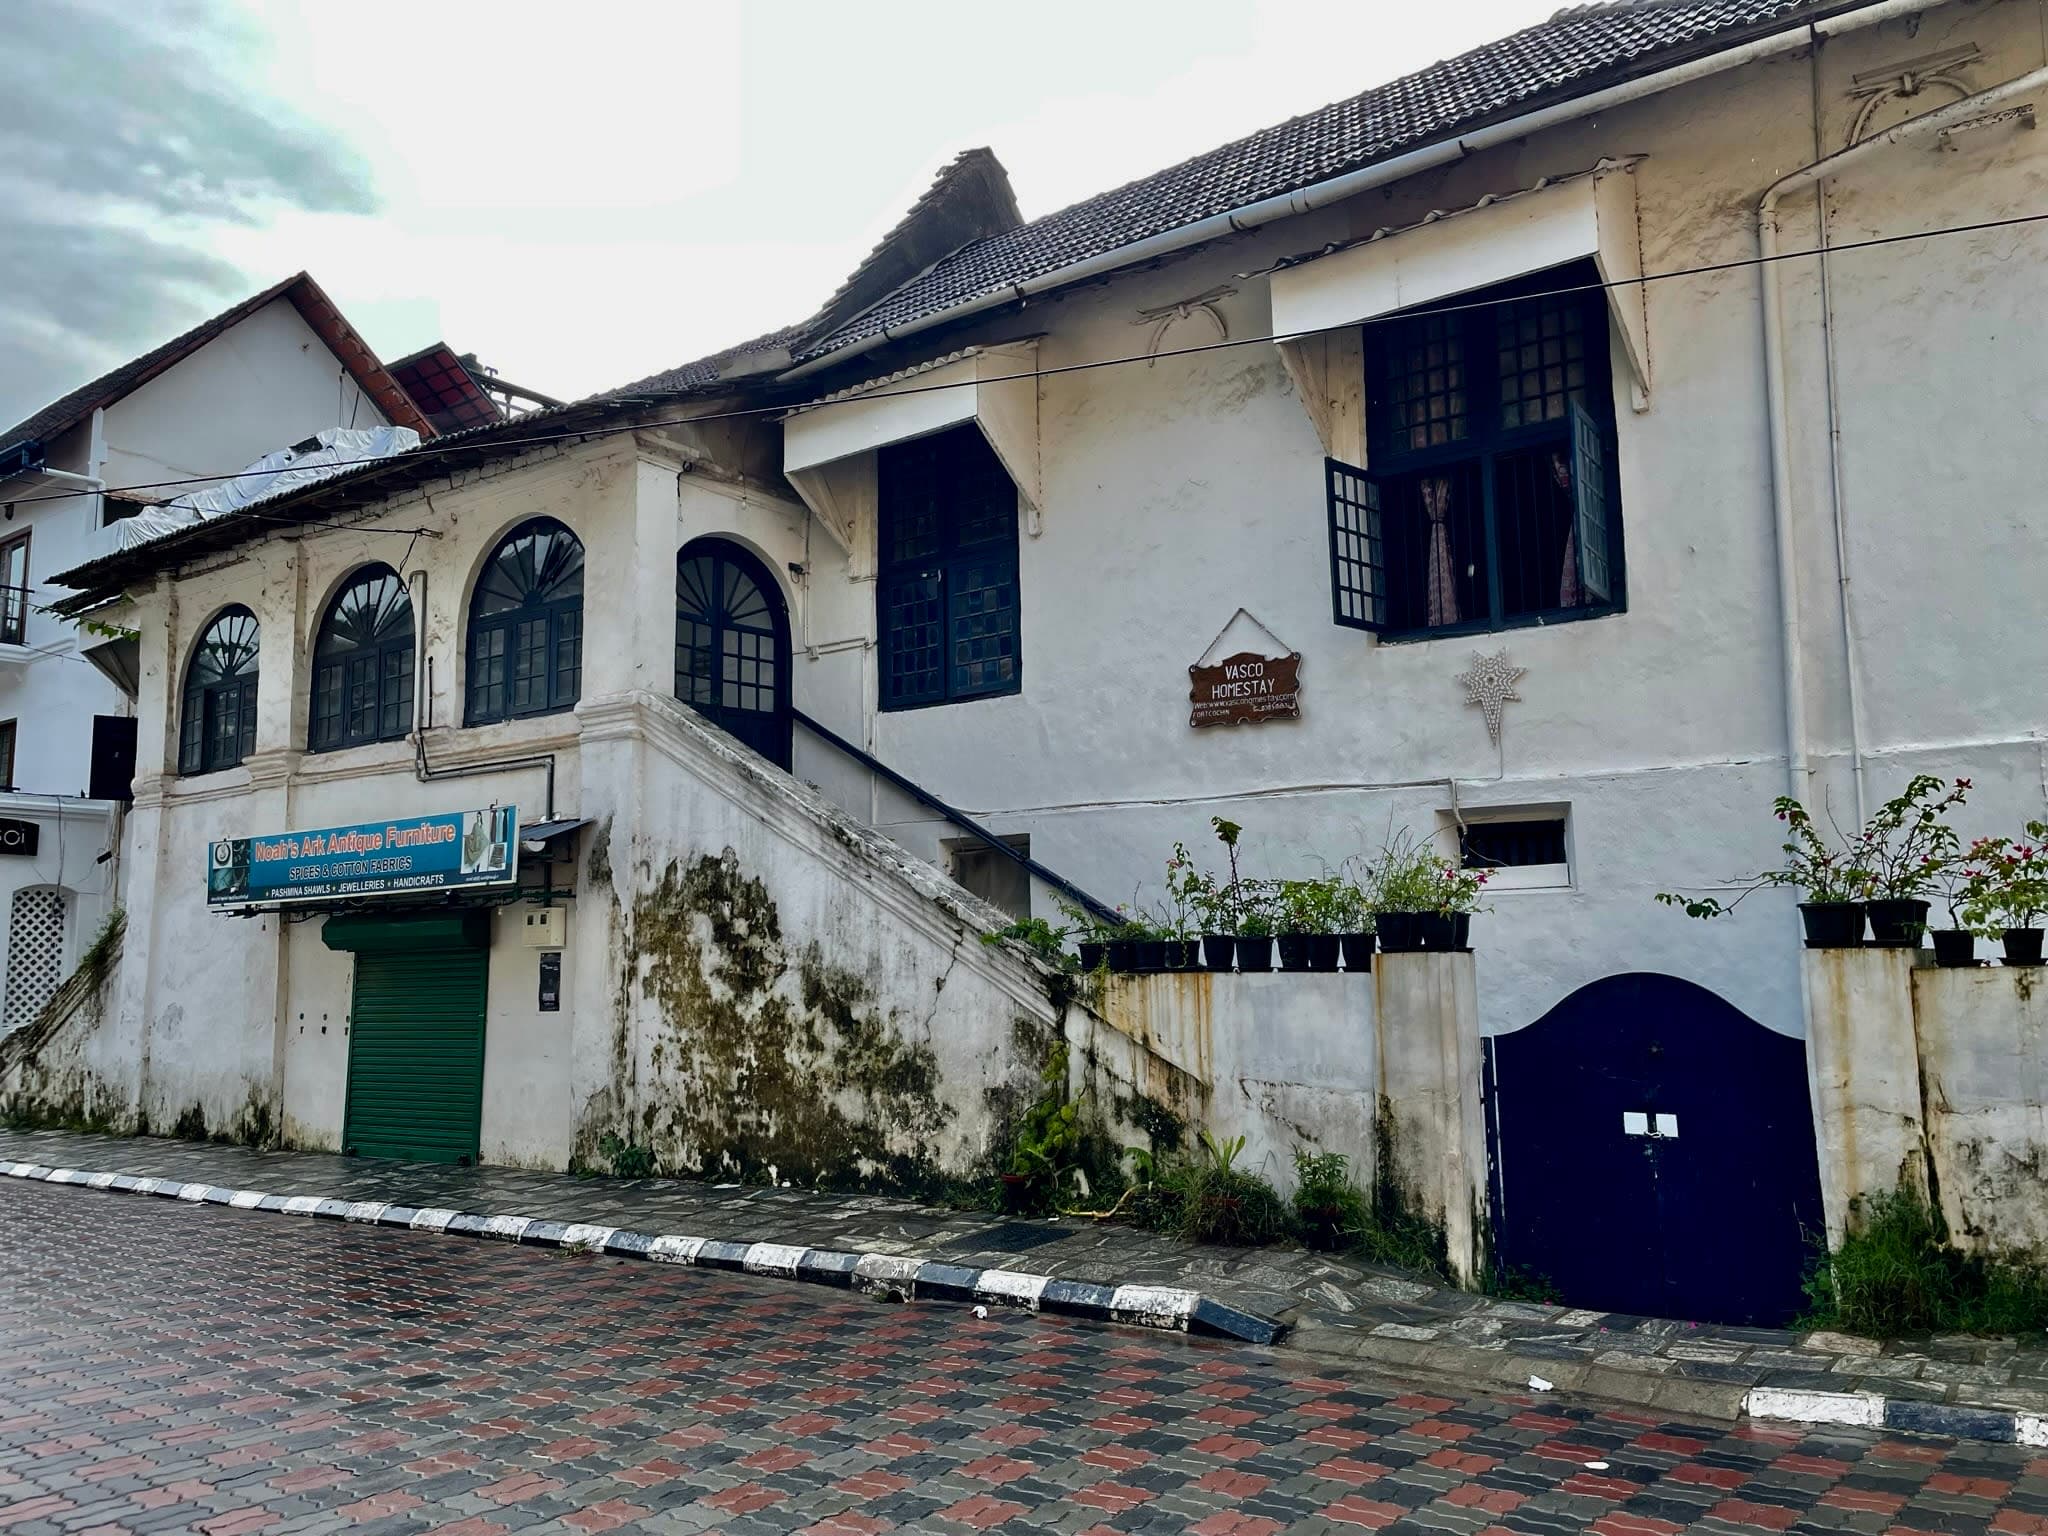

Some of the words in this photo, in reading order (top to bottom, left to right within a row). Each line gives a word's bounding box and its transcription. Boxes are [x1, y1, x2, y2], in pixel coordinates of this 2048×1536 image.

[1225, 663, 1264, 680] VASCO
[1212, 678, 1275, 699] HOMESTAY
[255, 838, 299, 862] Noah's
[300, 835, 326, 857] Ark
[327, 831, 383, 856] Antique
[386, 822, 456, 848] Furniture
[289, 864, 320, 881] SPICES
[322, 864, 329, 878] &
[331, 860, 368, 878] COTTON
[370, 856, 412, 873] FABRICS
[271, 886, 302, 898] PASHMINA
[304, 884, 330, 895] SHAWLS
[338, 880, 384, 893] JEWELLERIES
[393, 874, 444, 888] HANDICRAFTS
